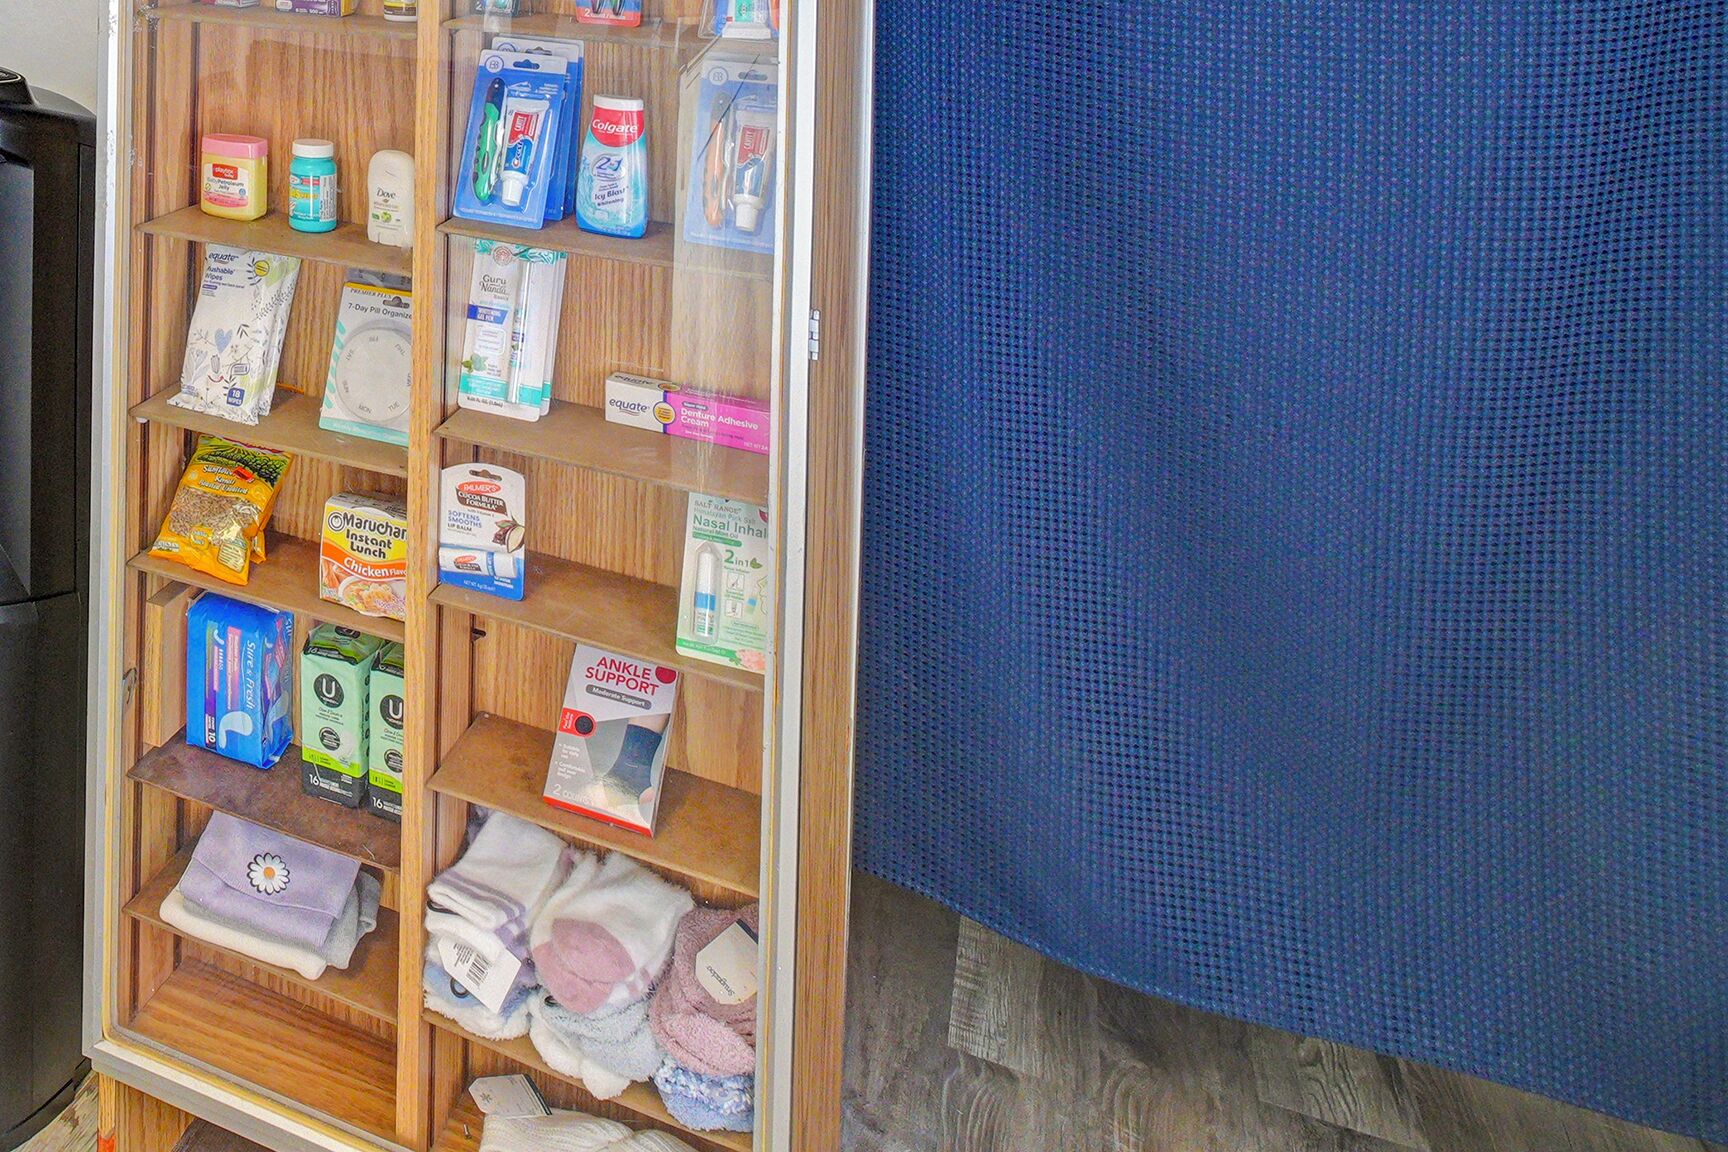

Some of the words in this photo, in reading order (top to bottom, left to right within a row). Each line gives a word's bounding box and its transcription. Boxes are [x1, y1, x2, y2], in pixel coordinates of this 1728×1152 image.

[592, 119, 638, 134] Colgate
[377, 187, 396, 199] Dove
[594, 192, 606, 201] Icy
[607, 187, 626, 198] Blast
[209, 252, 234, 262] equate
[482, 274, 507, 285] Guru
[348, 302, 369, 313] 7-Day
[370, 306, 381, 314] Pill
[614, 374, 654, 386] equate
[609, 397, 648, 413] equate
[680, 408, 717, 422] Denture
[718, 413, 759, 430] Adhesive
[680, 417, 710, 428] Cream
[458, 492, 481, 502] COCOA
[481, 495, 504, 507] BUTTER
[694, 500, 712, 509] SALT
[714, 504, 739, 515] RANGE
[447, 516, 482, 528] SMOOTHS
[448, 510, 480, 522] SOFTENS
[456, 524, 472, 532] BALM
[693, 514, 730, 531] Nasal
[734, 522, 768, 540] Inhal
[345, 528, 392, 550] Instant
[350, 541, 386, 559] Lunch
[343, 556, 389, 577] Chicken
[246, 640, 256, 666] Sure
[596, 656, 652, 681] ANKLE
[322, 677, 336, 698] U
[585, 666, 660, 697] SUPPORT
[246, 677, 256, 710] Fresh
[592, 686, 621, 700] Moderate
[621, 694, 646, 707] Support
[388, 698, 403, 720] U
[309, 774, 320, 786] 16
[552, 783, 561, 796] 2
[373, 797, 383, 809] 16
